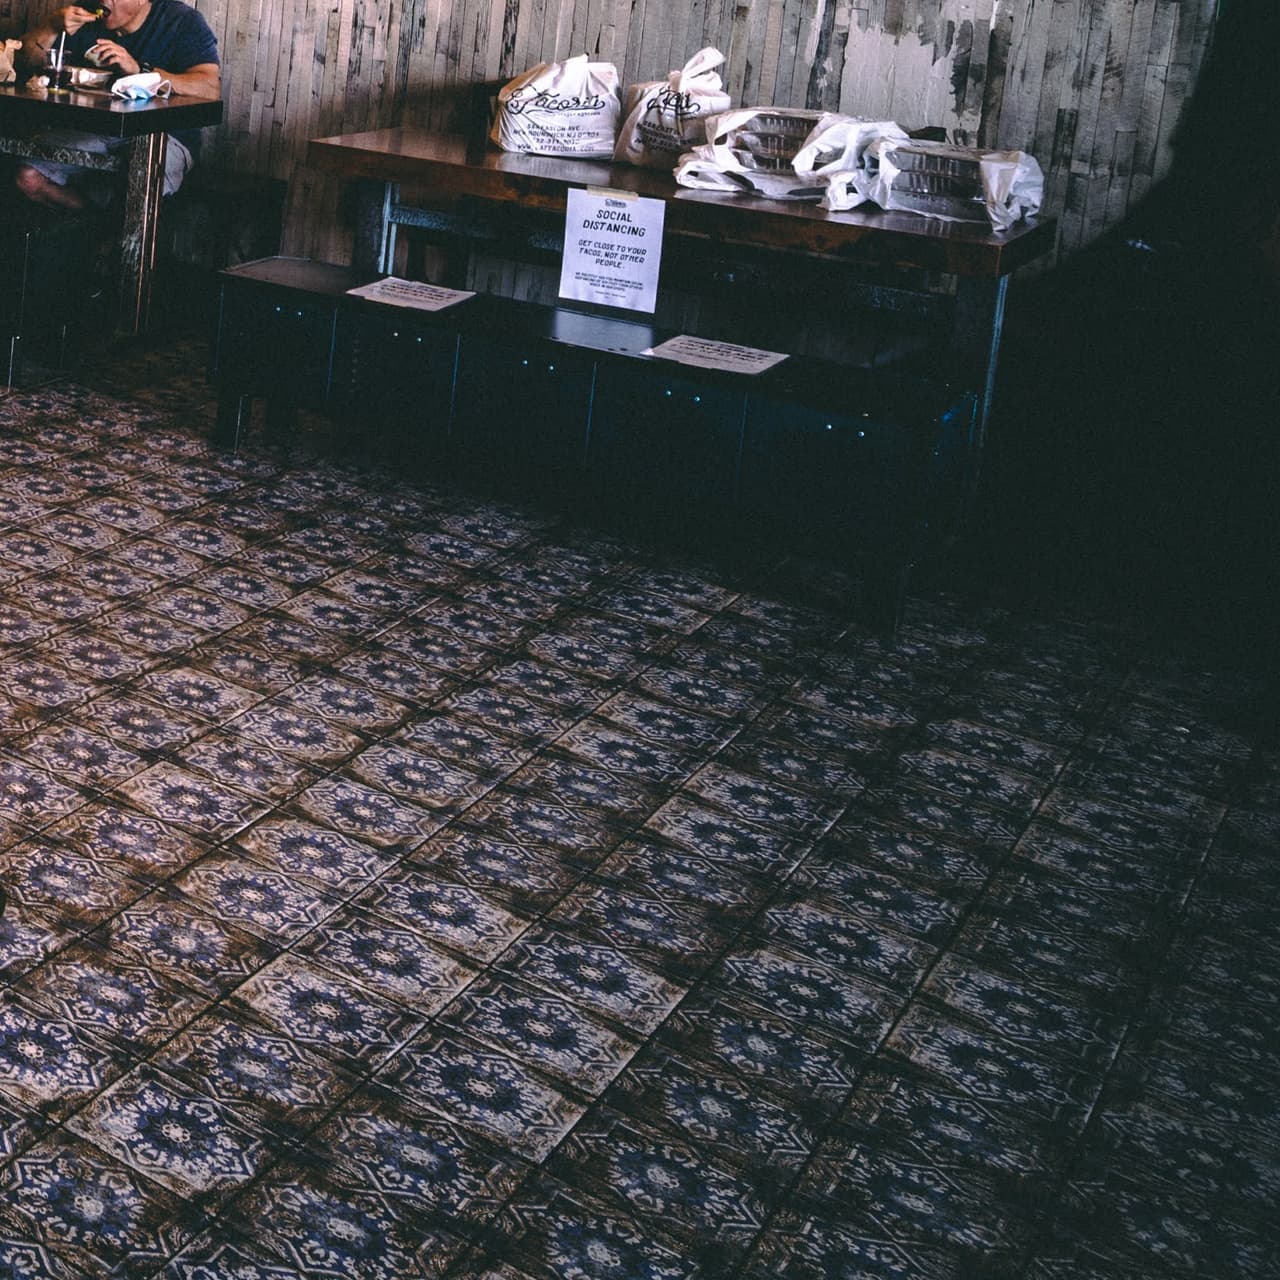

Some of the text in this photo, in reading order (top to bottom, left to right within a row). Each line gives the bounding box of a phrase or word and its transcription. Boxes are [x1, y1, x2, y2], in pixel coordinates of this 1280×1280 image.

[596, 209, 633, 224] SOCIAL
[582, 219, 647, 238] DISTANCING
[578, 239, 593, 248] GET
[593, 241, 615, 252] CLOSE
[603, 251, 619, 260] NOT
